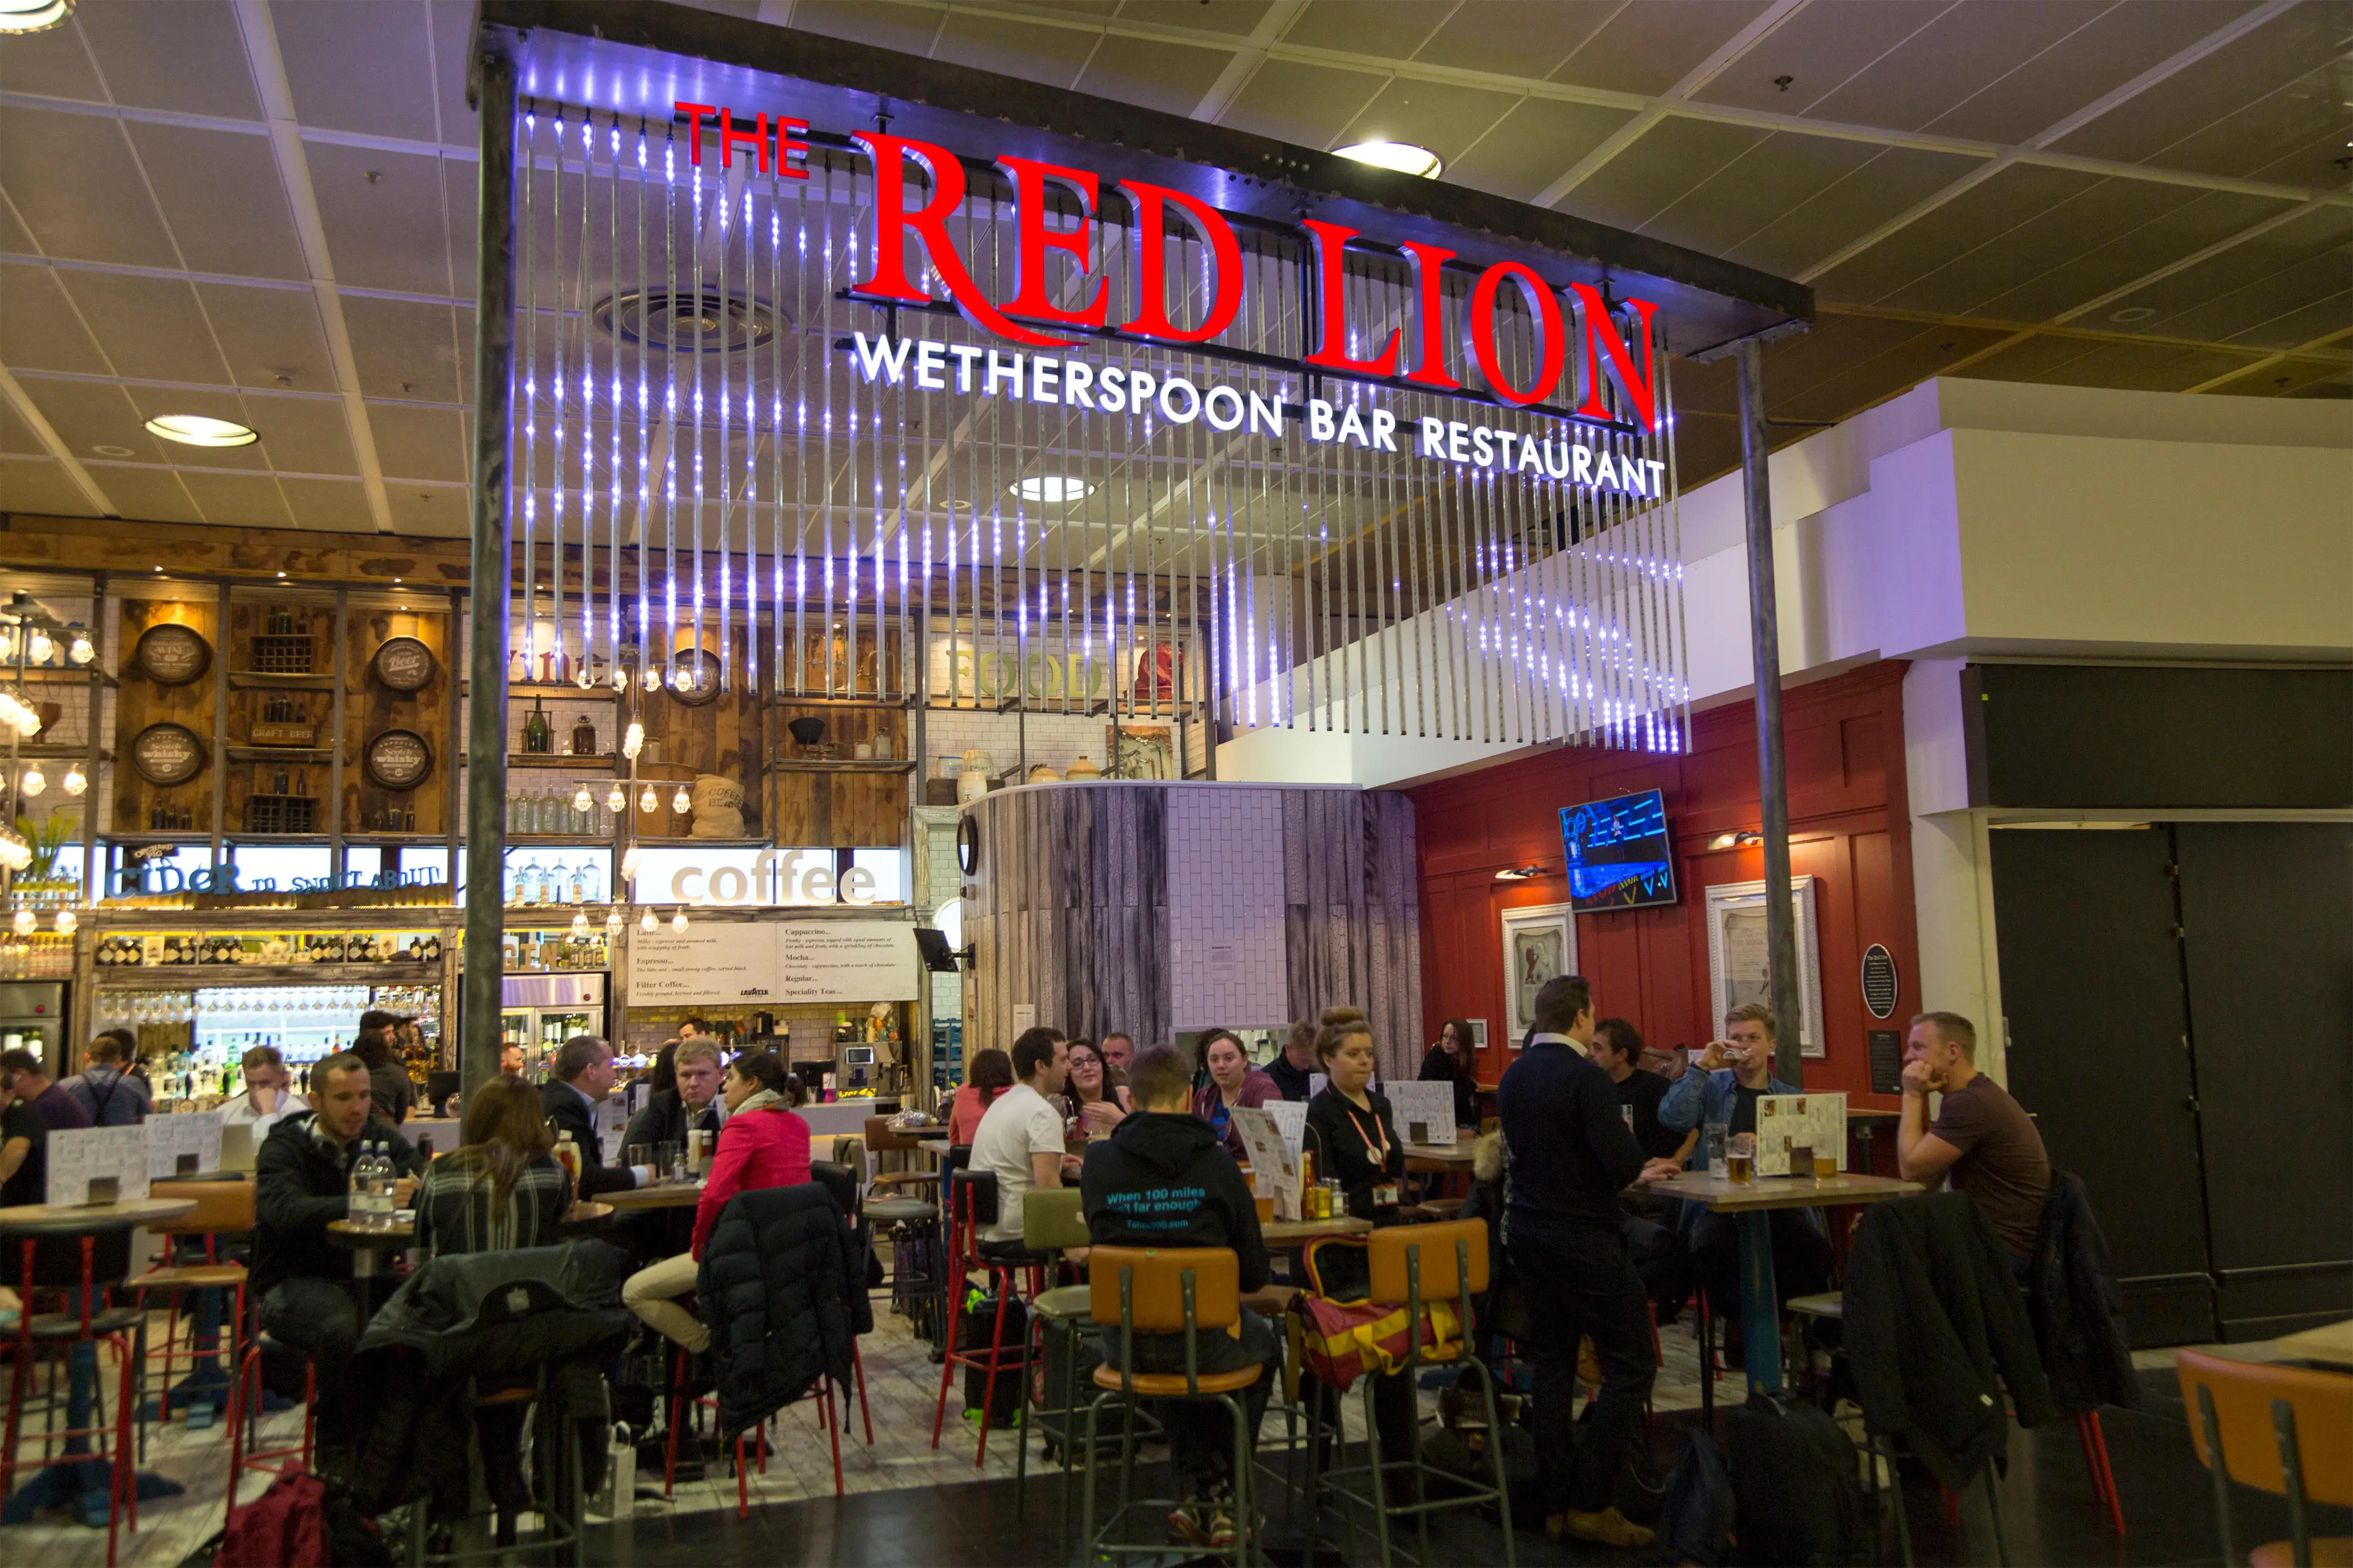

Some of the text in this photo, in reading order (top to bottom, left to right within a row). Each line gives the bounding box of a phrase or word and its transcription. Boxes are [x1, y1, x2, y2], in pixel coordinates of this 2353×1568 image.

[674, 102, 1659, 433] THE RED LION
[854, 331, 1666, 498] WETHERSPOON BAR RESTAURANT
[389, 655, 420, 667] Beer
[946, 650, 1102, 698] FOOD
[253, 729, 313, 739] CRAFT BEER
[142, 750, 191, 760] whisky
[376, 755, 421, 765] whisky
[135, 844, 173, 858] ORCHARD
[671, 848, 876, 906] coffee
[503, 943, 557, 971] GIN
[740, 987, 768, 995] LAVAZZA
[785, 989, 818, 997] Speciality
[1107, 1186, 1206, 1204] When 100 miles
[1134, 1202, 1151, 1213] far
